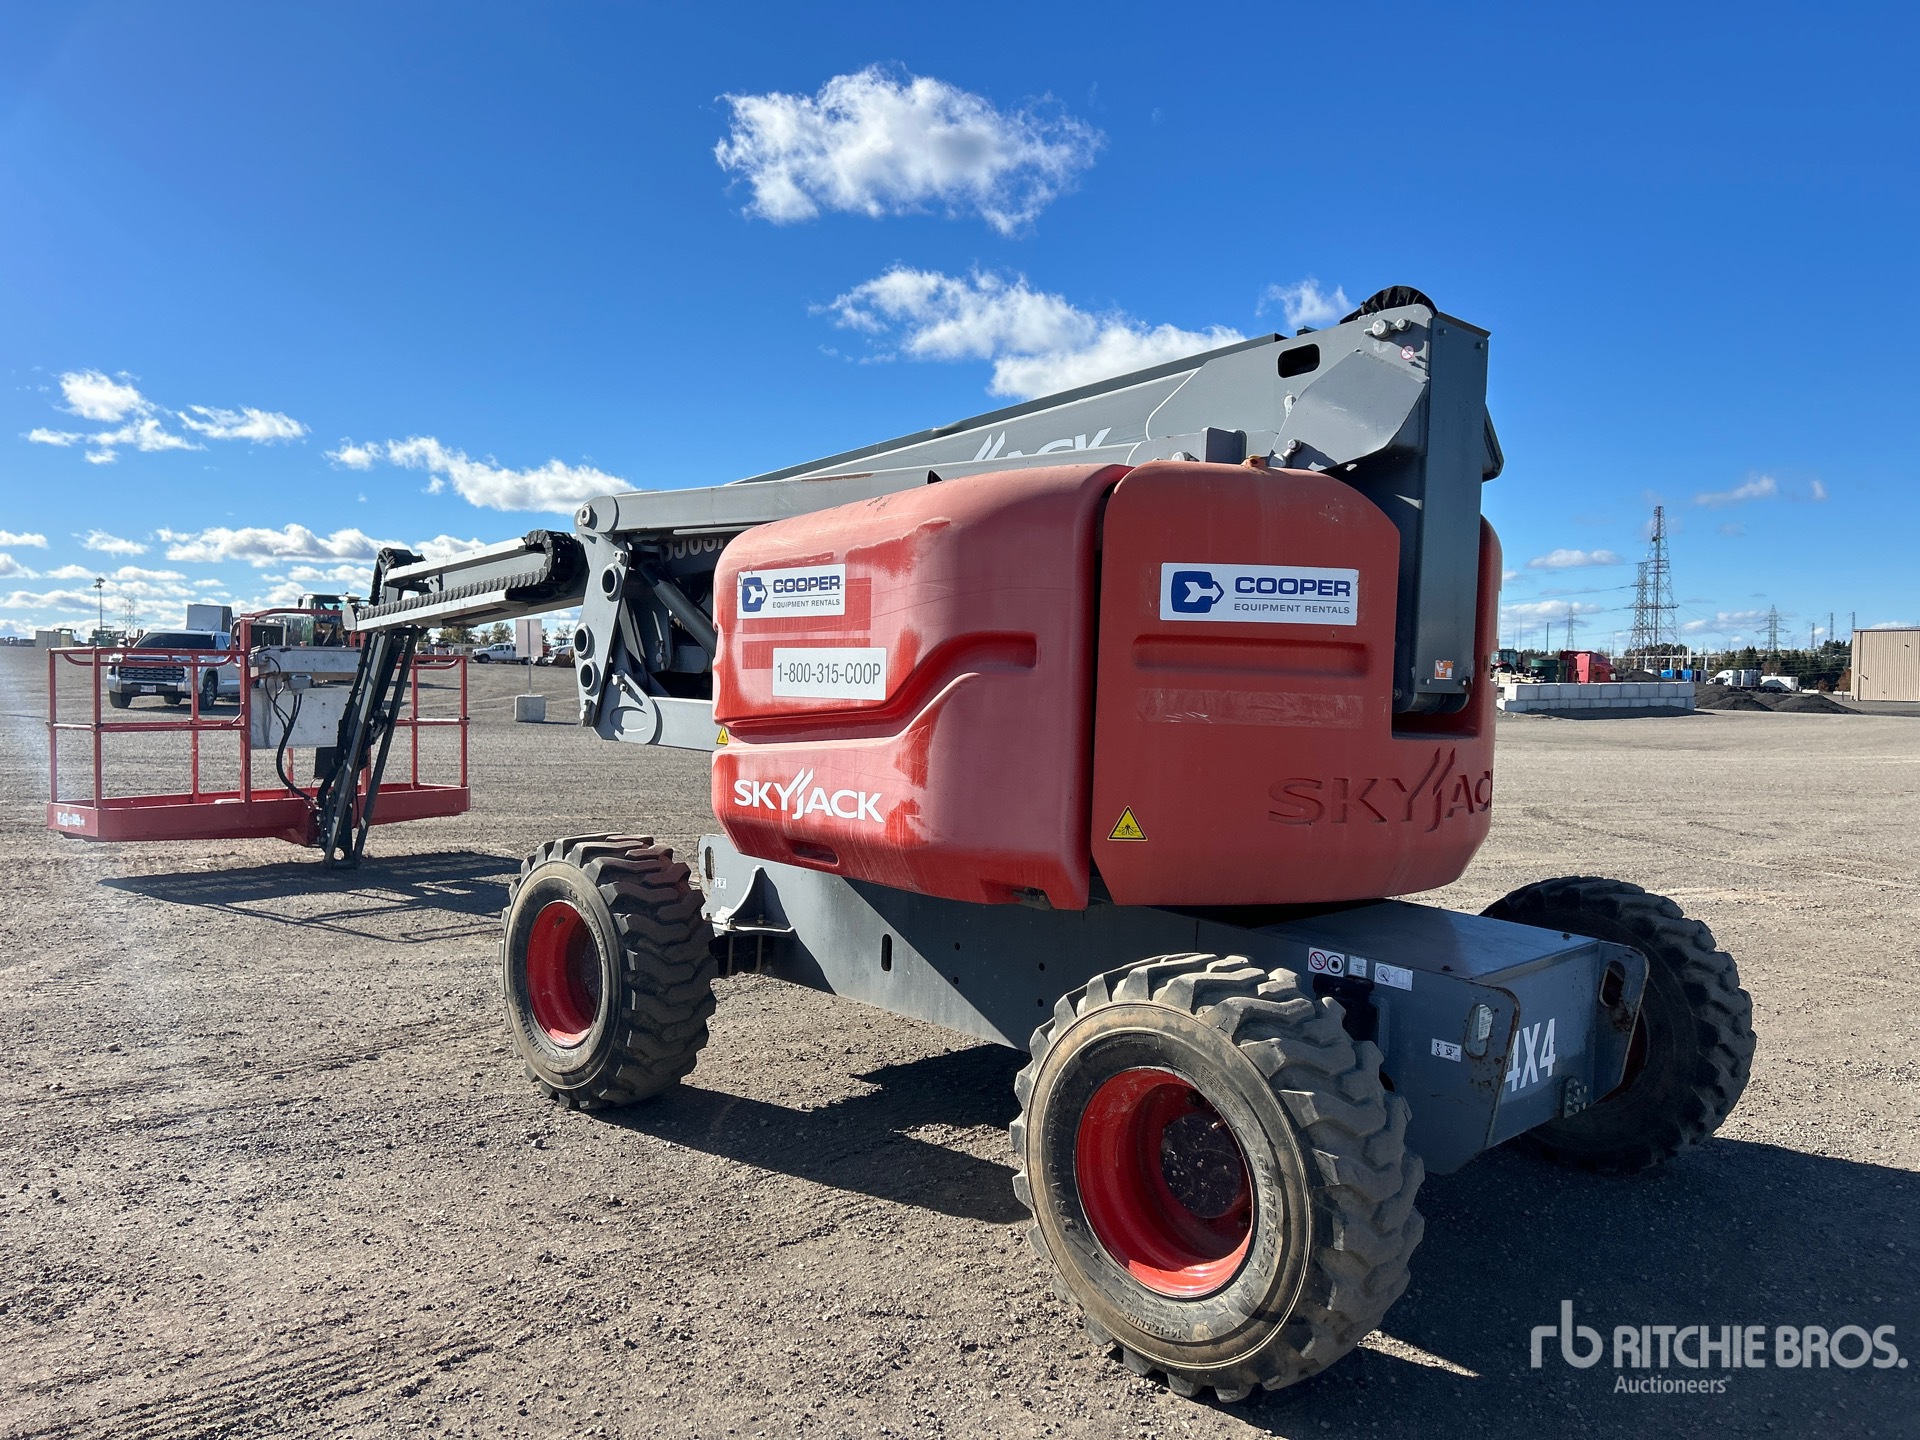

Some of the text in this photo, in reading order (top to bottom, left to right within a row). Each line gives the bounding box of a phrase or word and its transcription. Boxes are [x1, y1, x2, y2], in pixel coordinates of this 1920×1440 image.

[773, 575, 841, 593] COOPER
[1234, 576, 1351, 597] COOPER
[772, 599, 840, 609] EQUIPMENT RENTALS
[1233, 603, 1350, 614] EQUIPMENT RENTALS
[777, 662, 881, 685] 1-800-315-COOP
[733, 767, 885, 823] SKYJACK
[1268, 747, 1494, 833] SKYJAC
[1505, 1018, 1556, 1093] 4X4
